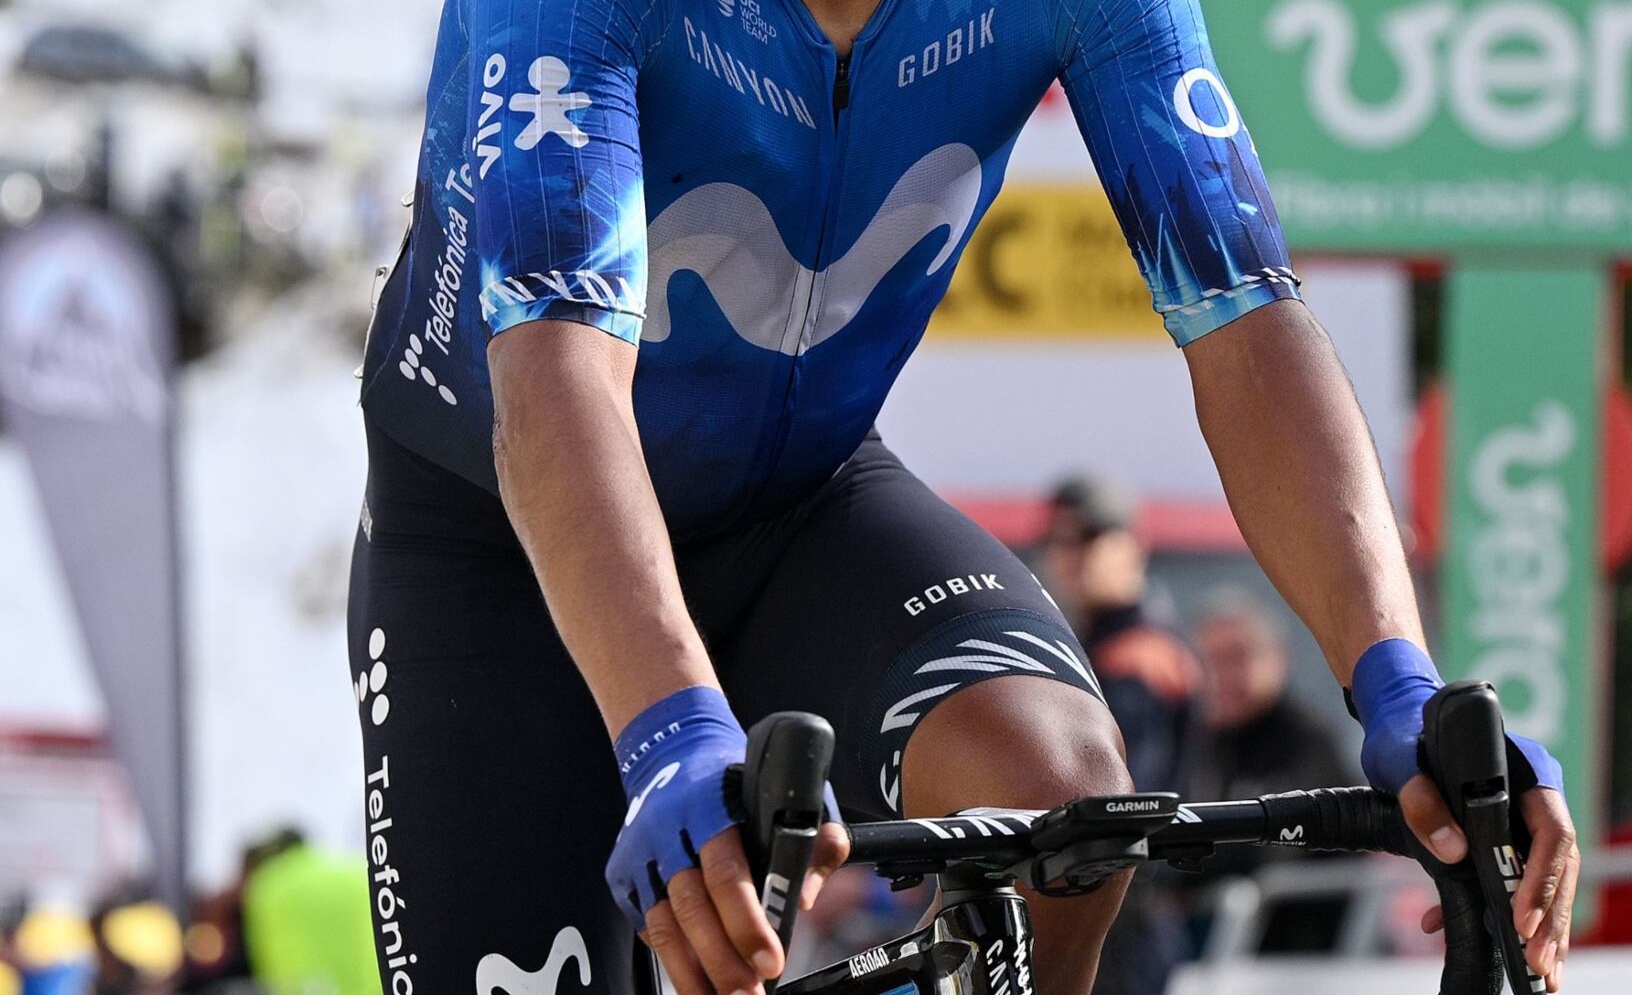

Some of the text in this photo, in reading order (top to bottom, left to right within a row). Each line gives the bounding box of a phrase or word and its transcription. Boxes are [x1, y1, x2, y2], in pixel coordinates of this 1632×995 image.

[740, 4, 777, 38] WORLD
[741, 16, 768, 45] TEAM
[898, 8, 996, 88] GOBIK
[684, 16, 817, 129] CANYON
[424, 206, 468, 356] Telefónica
[904, 573, 1005, 617] GOBIK
[1106, 800, 1159, 813] GARMIN
[849, 947, 890, 979] AEROAD
